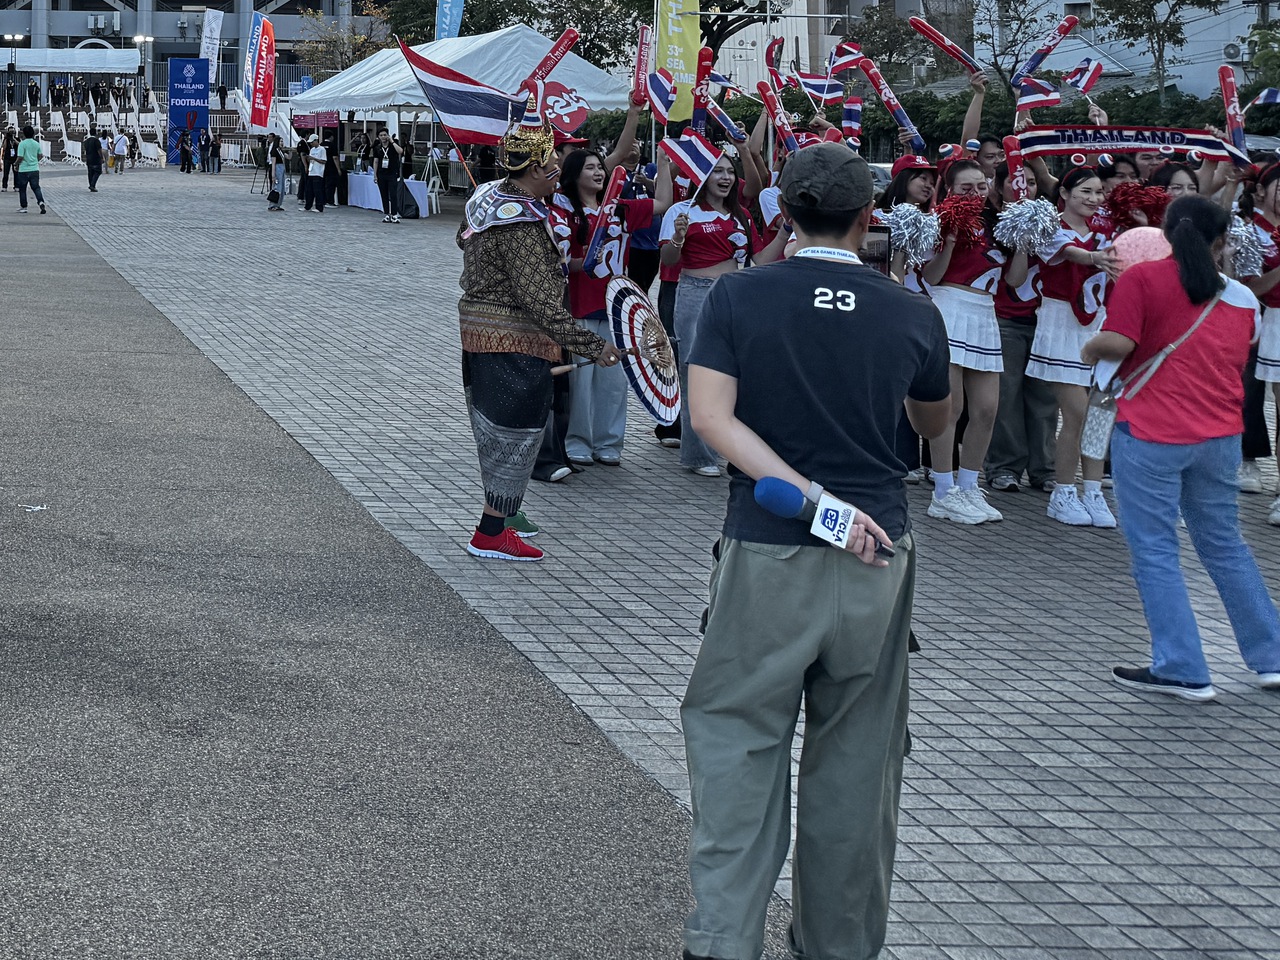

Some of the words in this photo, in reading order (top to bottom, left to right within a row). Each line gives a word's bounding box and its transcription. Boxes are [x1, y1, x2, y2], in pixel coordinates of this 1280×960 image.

[256, 35, 269, 89] THAILAND
[666, 58, 685, 71] SEA
[171, 98, 209, 107] FOOTBALL
[1055, 129, 1188, 145] THAILAND
[814, 287, 856, 312] 23
[825, 510, 838, 528] 23
[832, 522, 847, 543] ข่าว
